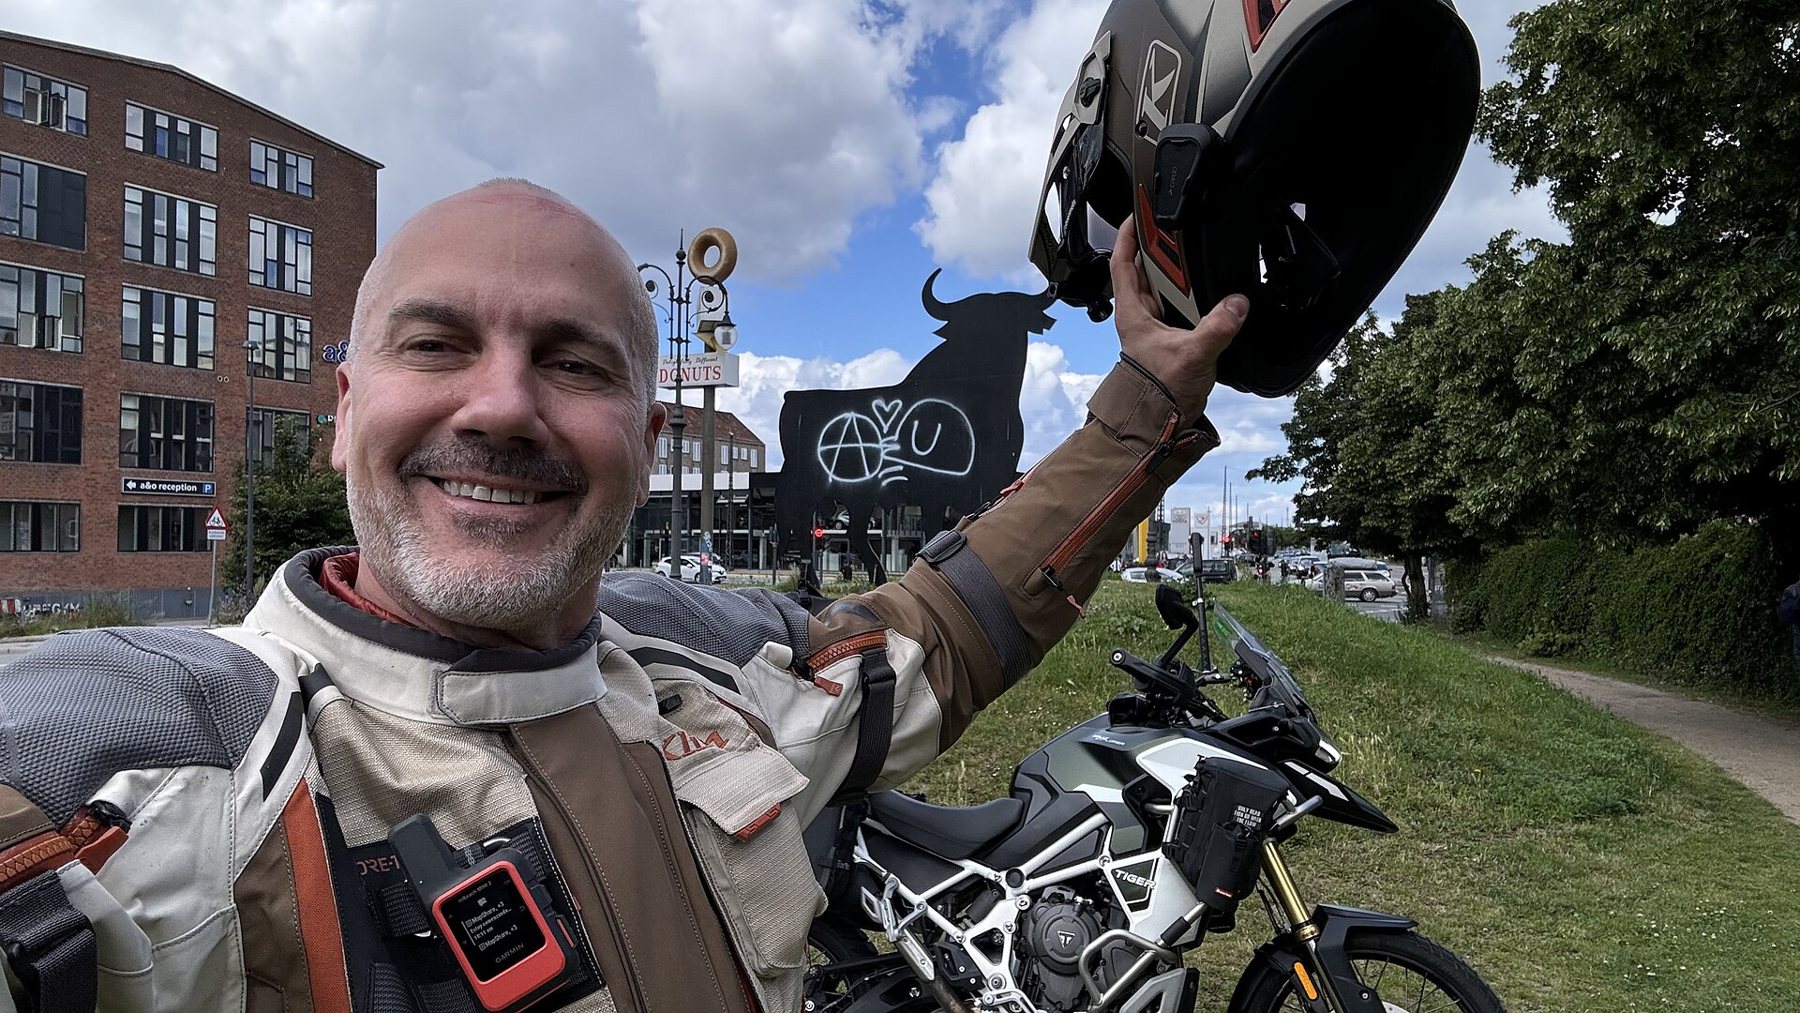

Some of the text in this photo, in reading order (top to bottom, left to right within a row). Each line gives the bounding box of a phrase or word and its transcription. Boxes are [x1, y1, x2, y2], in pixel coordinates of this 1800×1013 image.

[322, 340, 349, 363] a&
[658, 366, 721, 384] DONUTS
[911, 420, 942, 456] U
[140, 482, 157, 490] a&o
[158, 483, 198, 492] reception
[1114, 869, 1156, 890] TIGER
[495, 943, 524, 963] GARMIN
